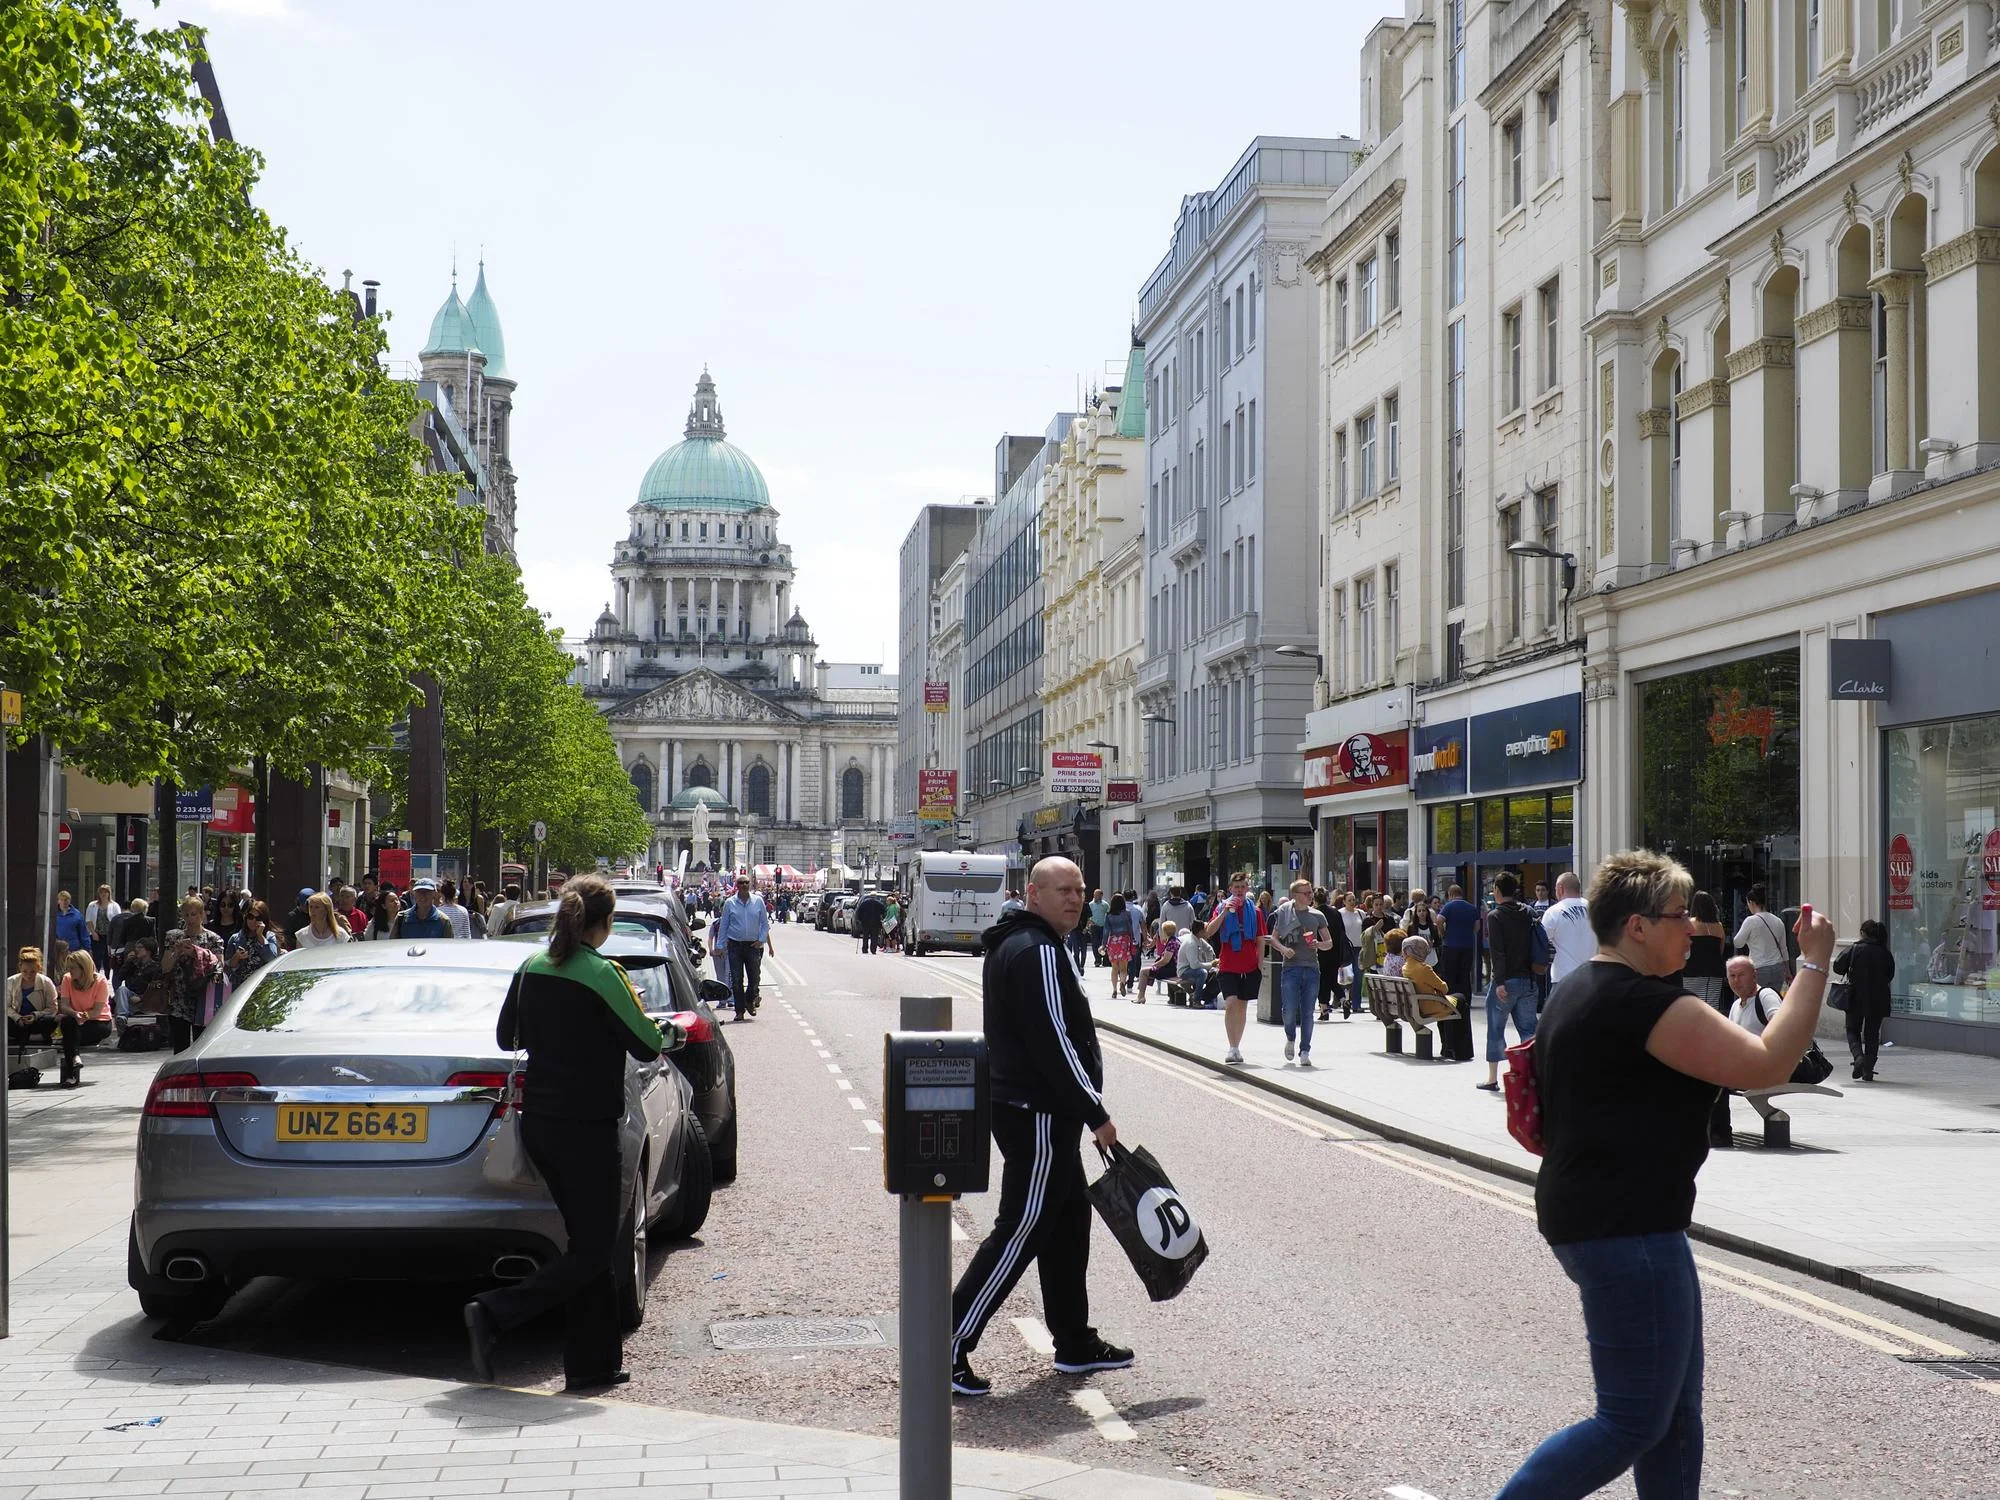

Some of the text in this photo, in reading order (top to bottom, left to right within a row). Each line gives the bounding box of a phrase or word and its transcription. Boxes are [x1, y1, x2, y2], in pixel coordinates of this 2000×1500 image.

[1838, 680, 1885, 694] Clarks
[1505, 734, 1549, 758] everything
[1109, 791, 1136, 800] oasis
[1889, 861, 1912, 877] SALE
[1920, 870, 1939, 879] kids
[1920, 881, 1953, 889] upstairs
[909, 1059, 971, 1067] PEDESTRIANS
[239, 1117, 260, 1125] XF
[288, 1111, 417, 1136] UNZ 6643
[1154, 1198, 1191, 1252] JD
